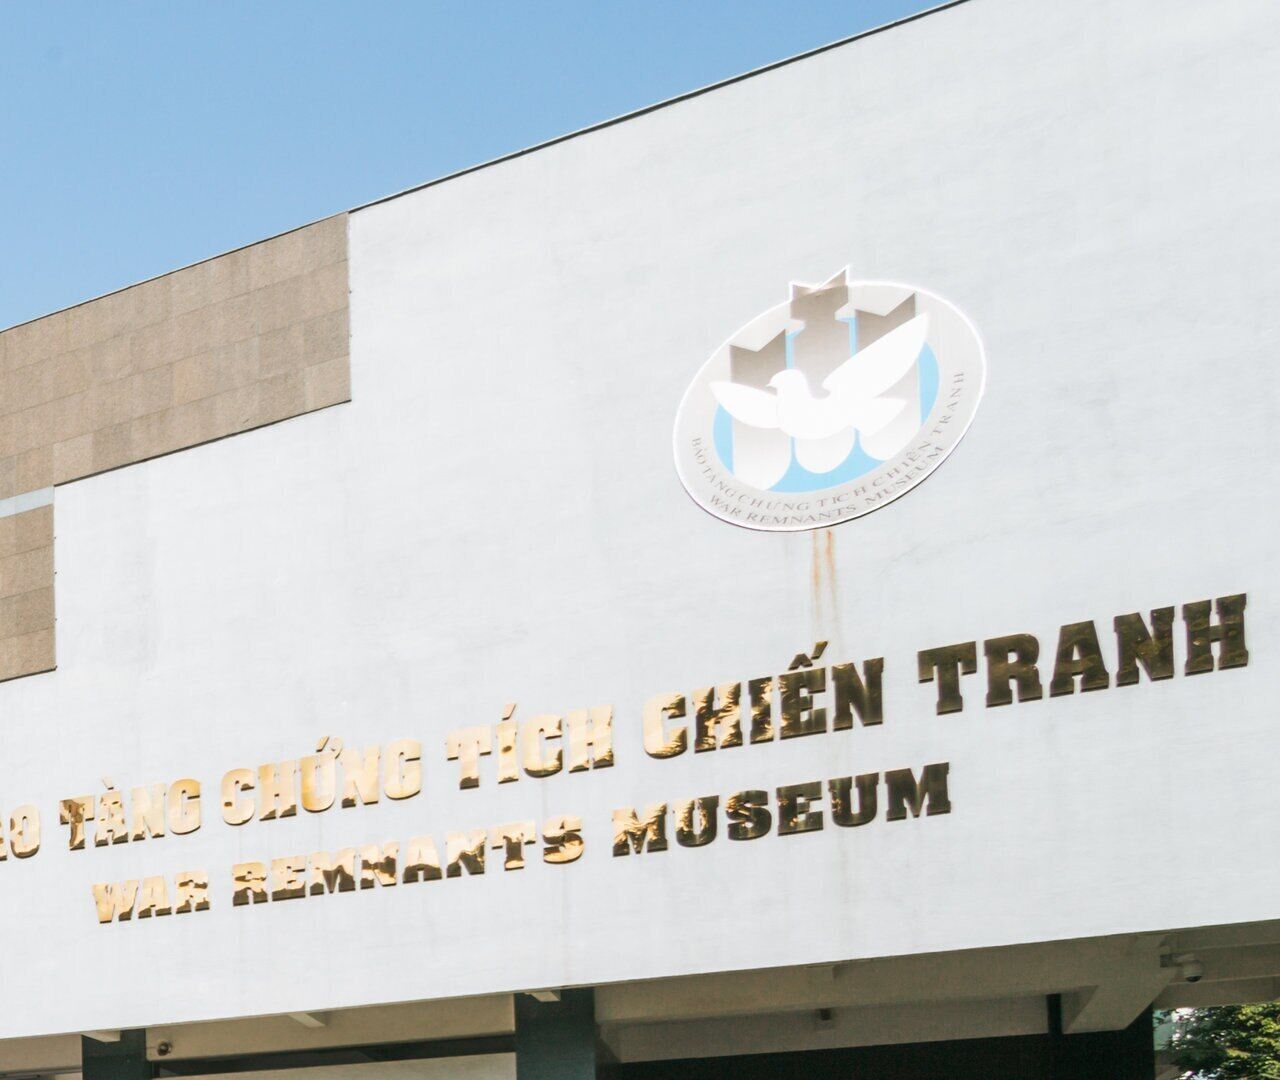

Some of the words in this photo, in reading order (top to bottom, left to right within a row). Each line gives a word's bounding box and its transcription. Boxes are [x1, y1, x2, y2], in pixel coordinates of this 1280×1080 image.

[930, 371, 965, 437] TRANH
[710, 494, 742, 518] WAR
[746, 504, 857, 525] REMNANTS
[865, 446, 944, 506] MUSEUM
[59, 776, 203, 850] TÀNG
[220, 736, 422, 826] CHỨNG
[447, 703, 615, 790] TÍCH
[644, 640, 885, 760] CHIẾN
[917, 593, 1249, 716] TRANH
[92, 870, 210, 923] WAR
[231, 815, 585, 907] REMNANTS
[612, 762, 952, 857] MUSEUM
